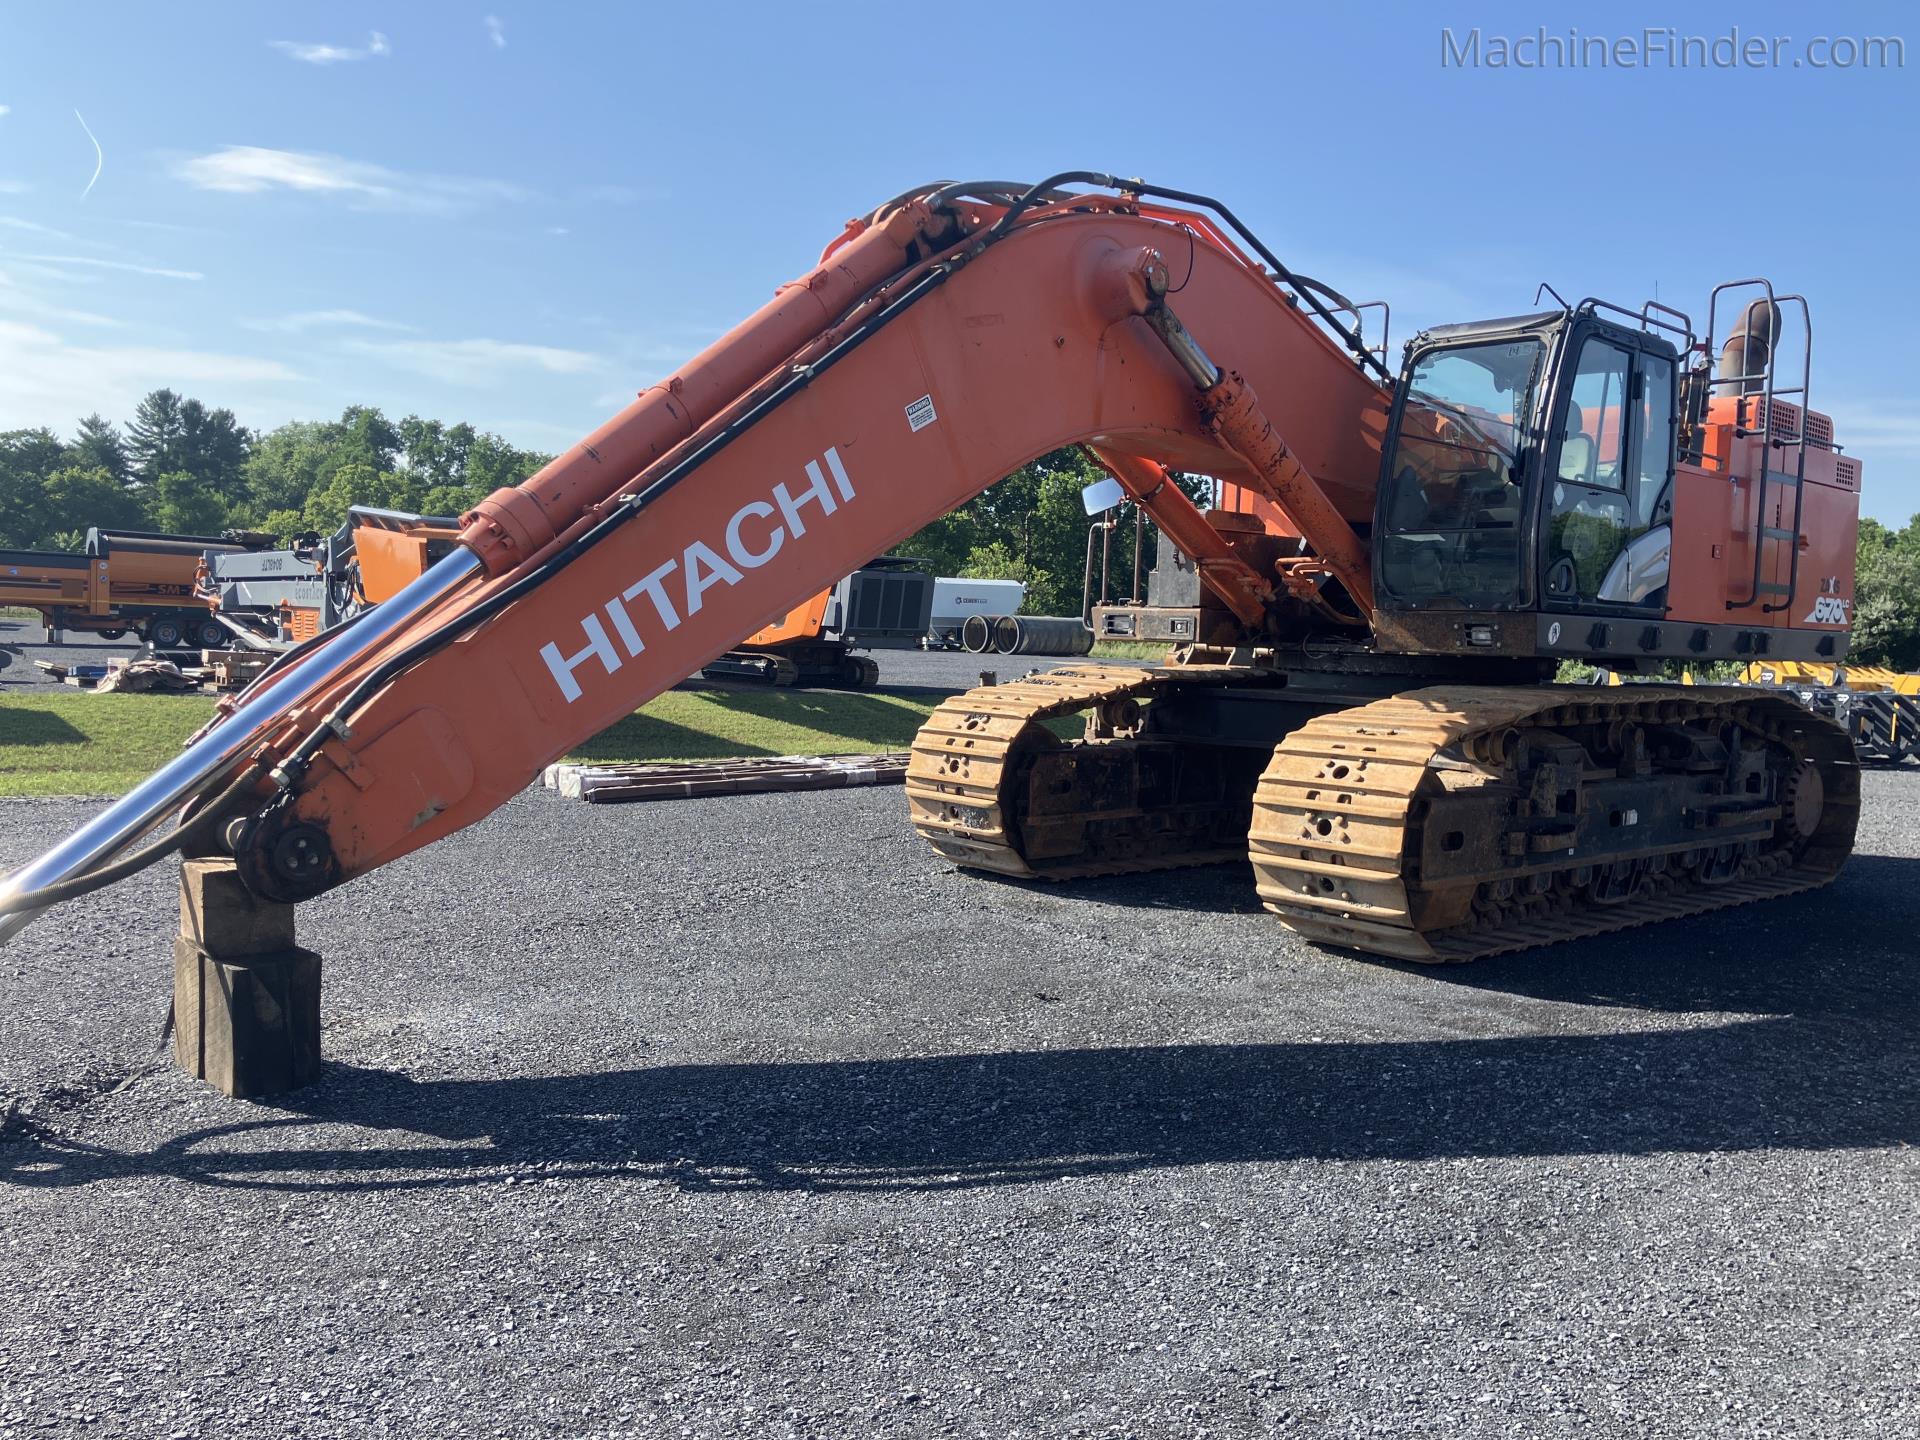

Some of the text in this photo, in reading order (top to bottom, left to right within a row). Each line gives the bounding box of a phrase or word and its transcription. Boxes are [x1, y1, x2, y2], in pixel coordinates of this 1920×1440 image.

[539, 446, 856, 703] HITACHI
[1820, 576, 1840, 594] ZAXIS
[1815, 596, 1842, 622] 670
